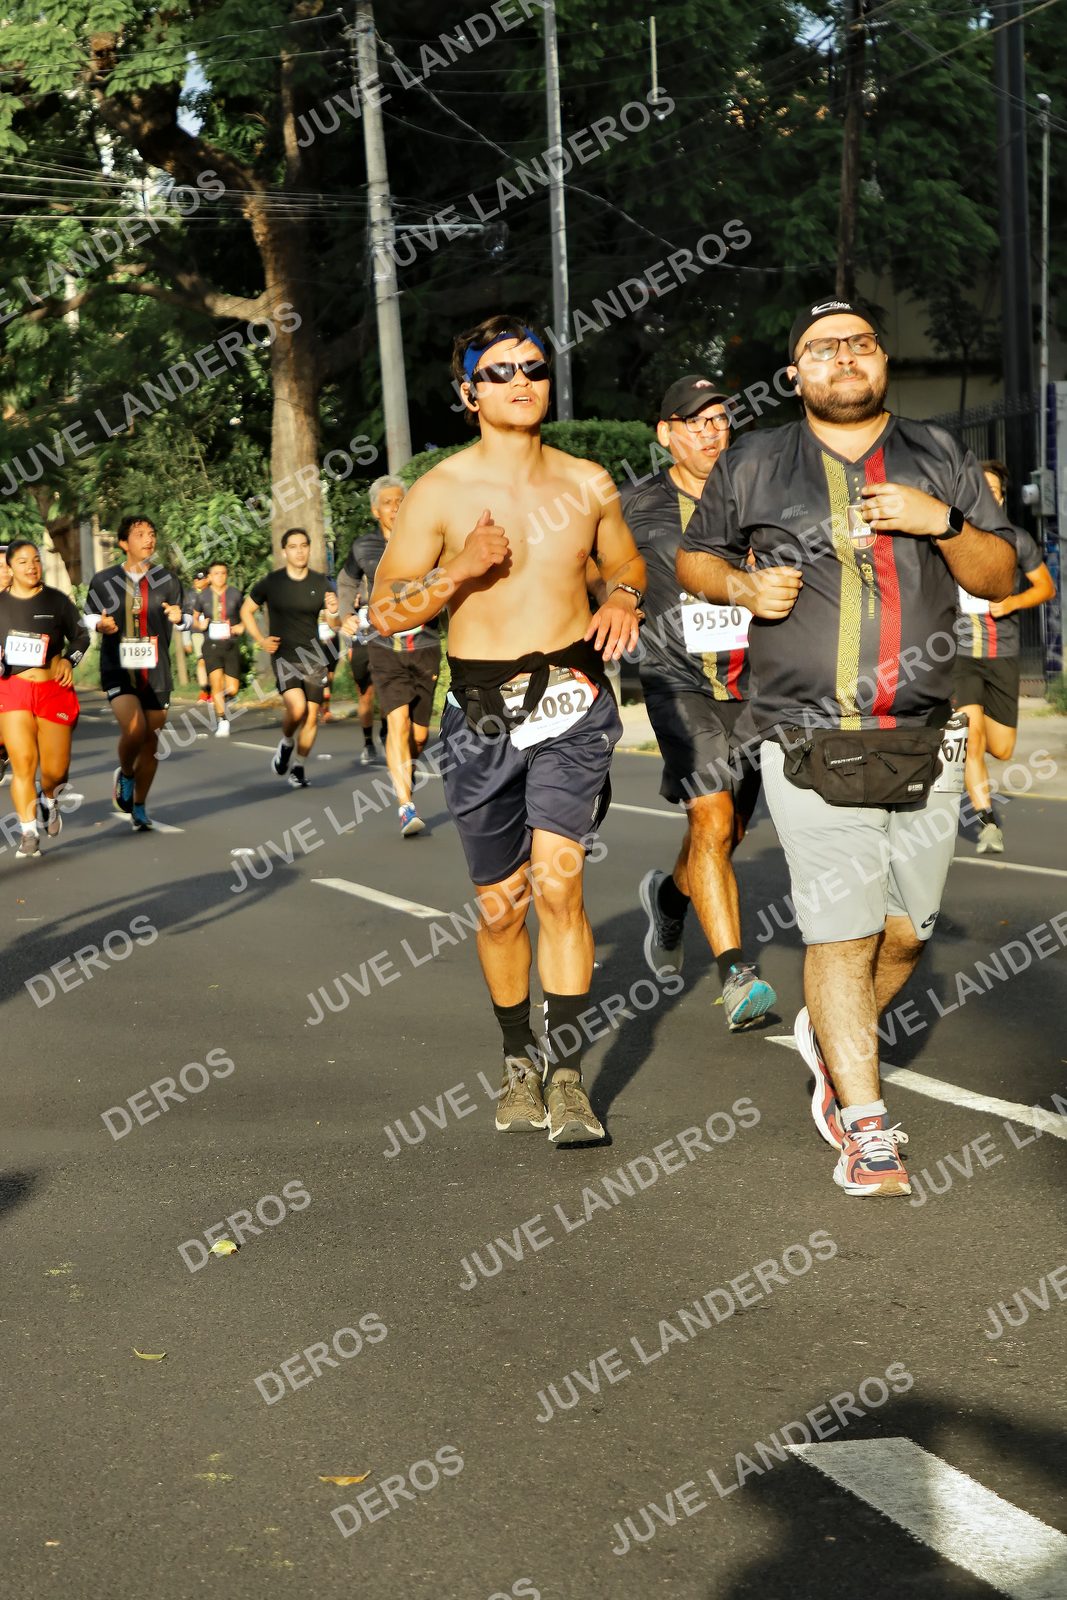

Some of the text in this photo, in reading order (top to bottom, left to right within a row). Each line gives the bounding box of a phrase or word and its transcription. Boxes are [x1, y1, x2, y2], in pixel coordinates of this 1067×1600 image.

[692, 607, 742, 632] 9550
[9, 640, 42, 655] 12510
[121, 646, 153, 658] 11895
[510, 688, 590, 723] 2082
